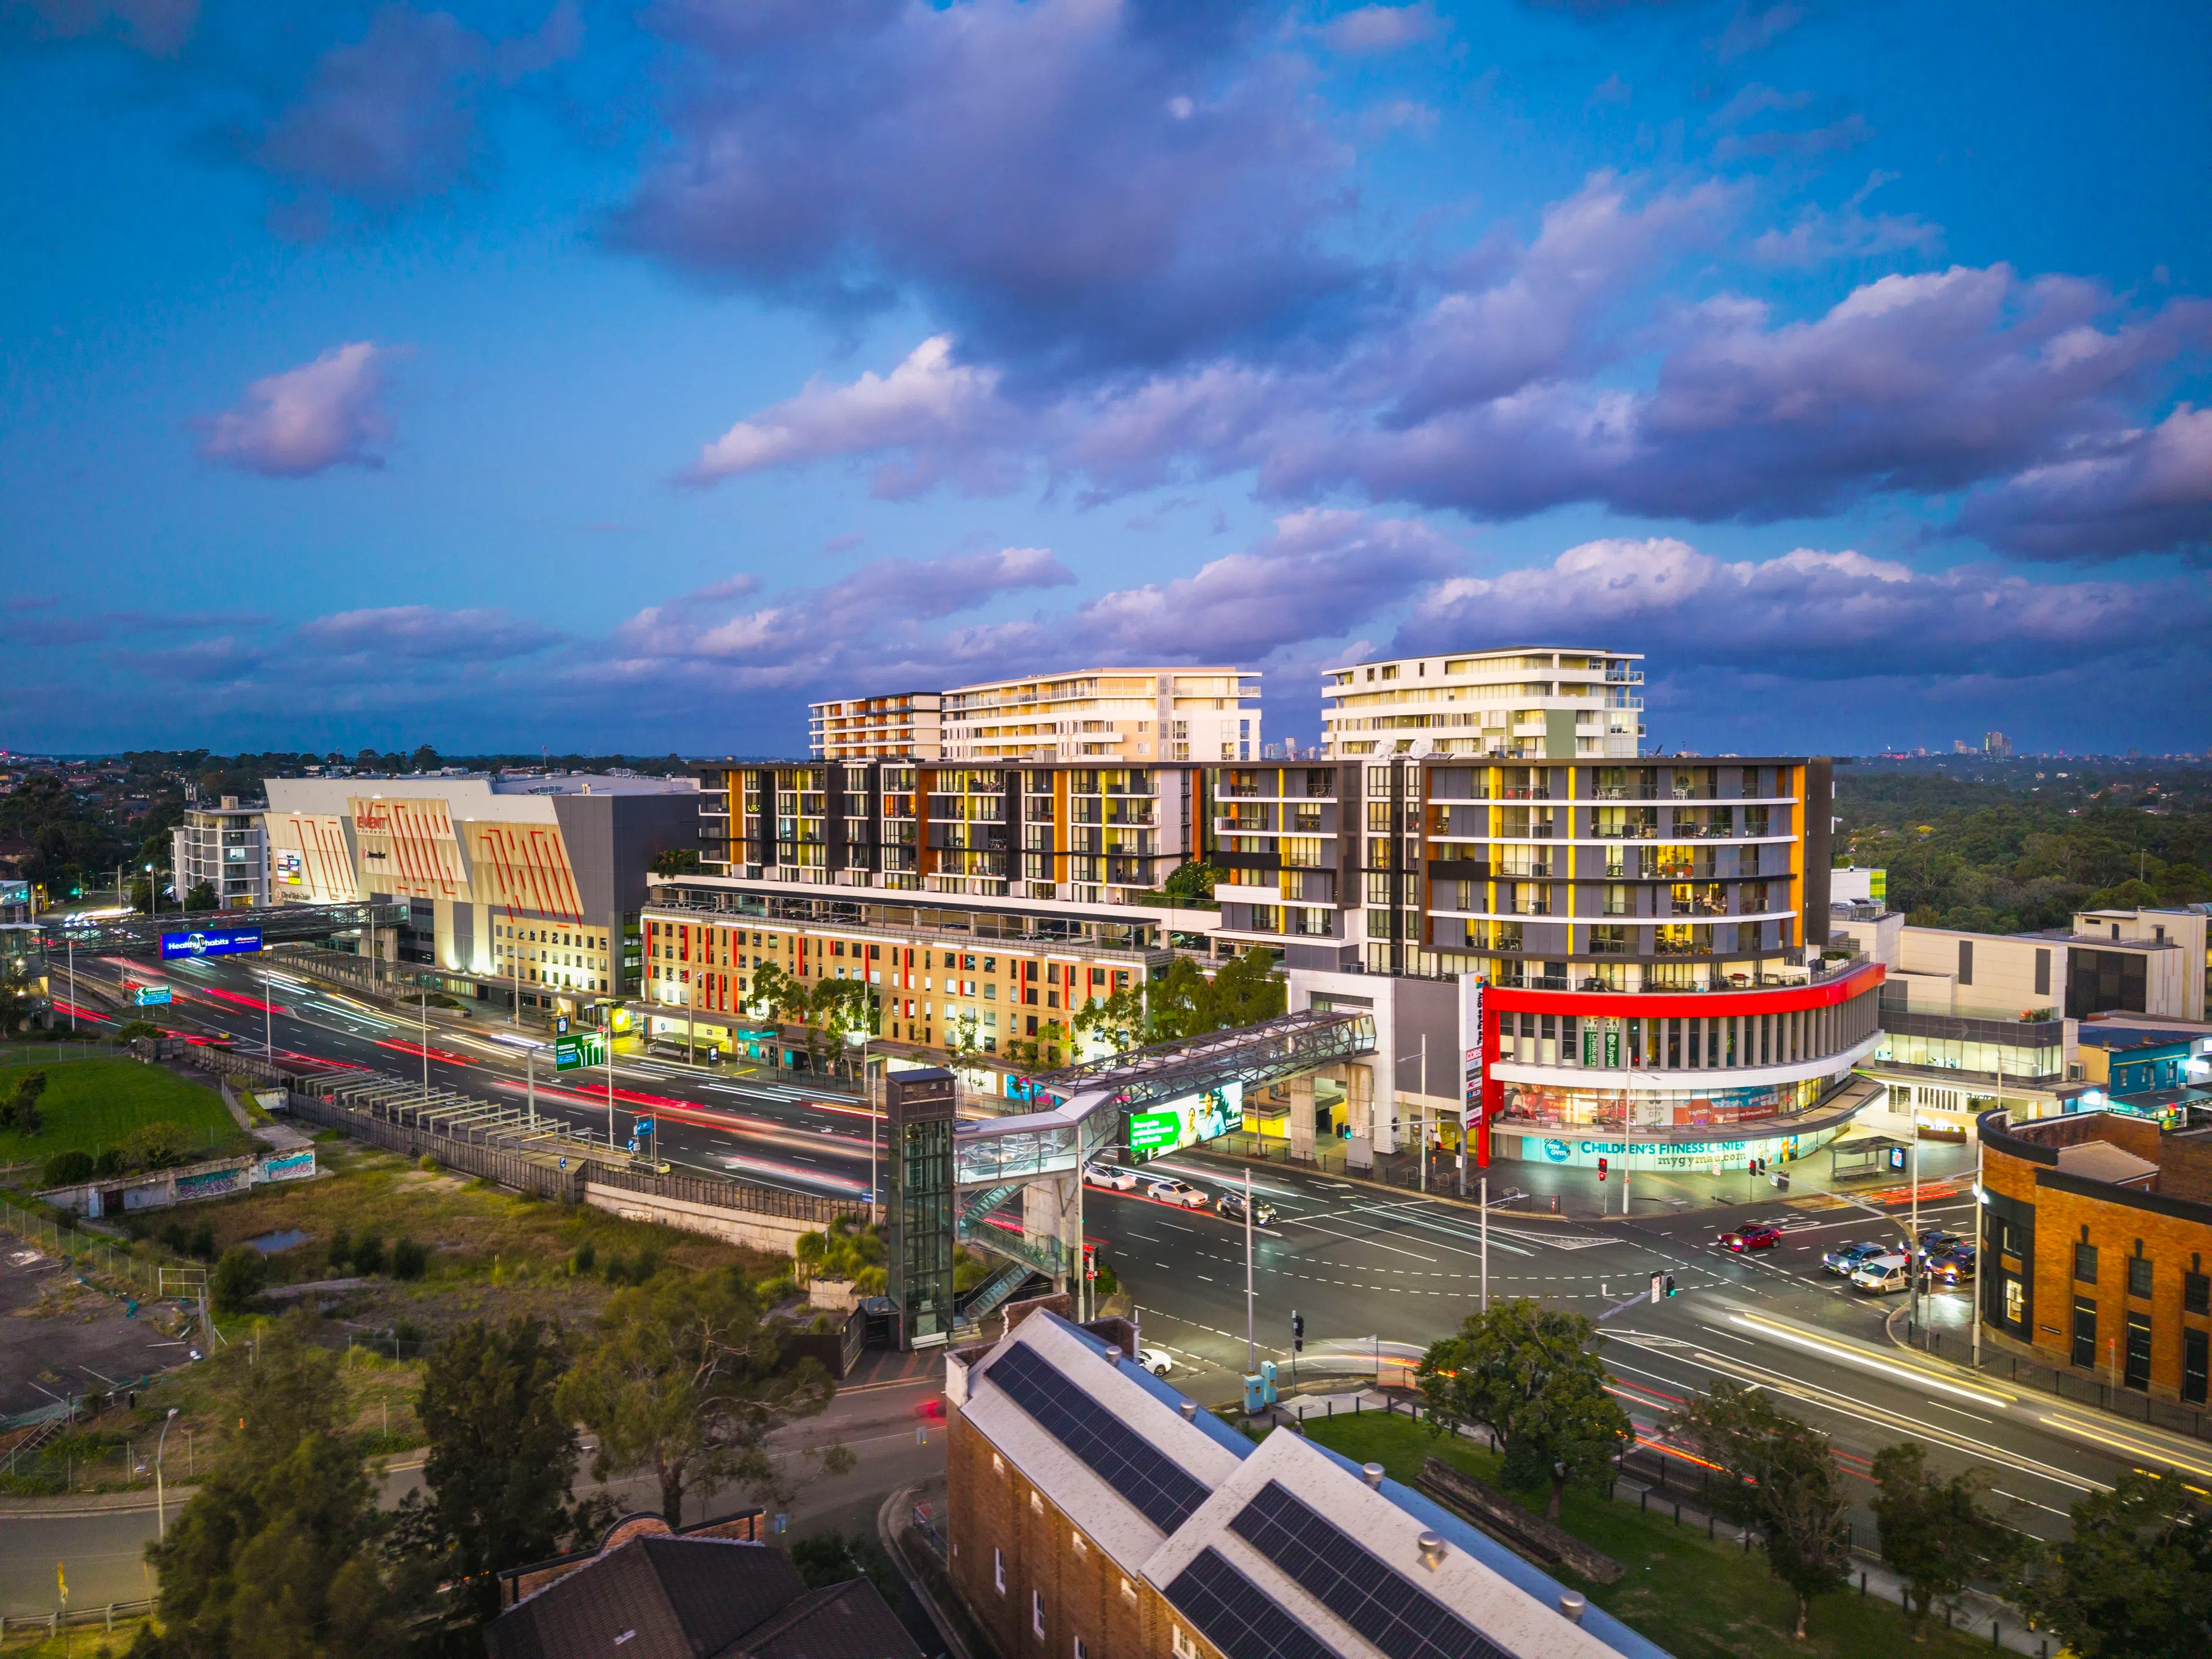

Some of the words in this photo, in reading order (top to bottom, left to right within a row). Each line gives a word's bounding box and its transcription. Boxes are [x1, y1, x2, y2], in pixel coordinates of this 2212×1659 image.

[168, 940, 199, 950] Healthy
[205, 939, 229, 947] habits
[1467, 1048, 1482, 1060] coles
[1607, 1043, 1616, 1067] Lilypad
[1581, 1141, 1656, 1154] CHILDREN'S
[1659, 1143, 1705, 1155] FITNESS
[1707, 1140, 1746, 1154] CENTER
[1657, 1153, 1747, 1167] mygymau.com
